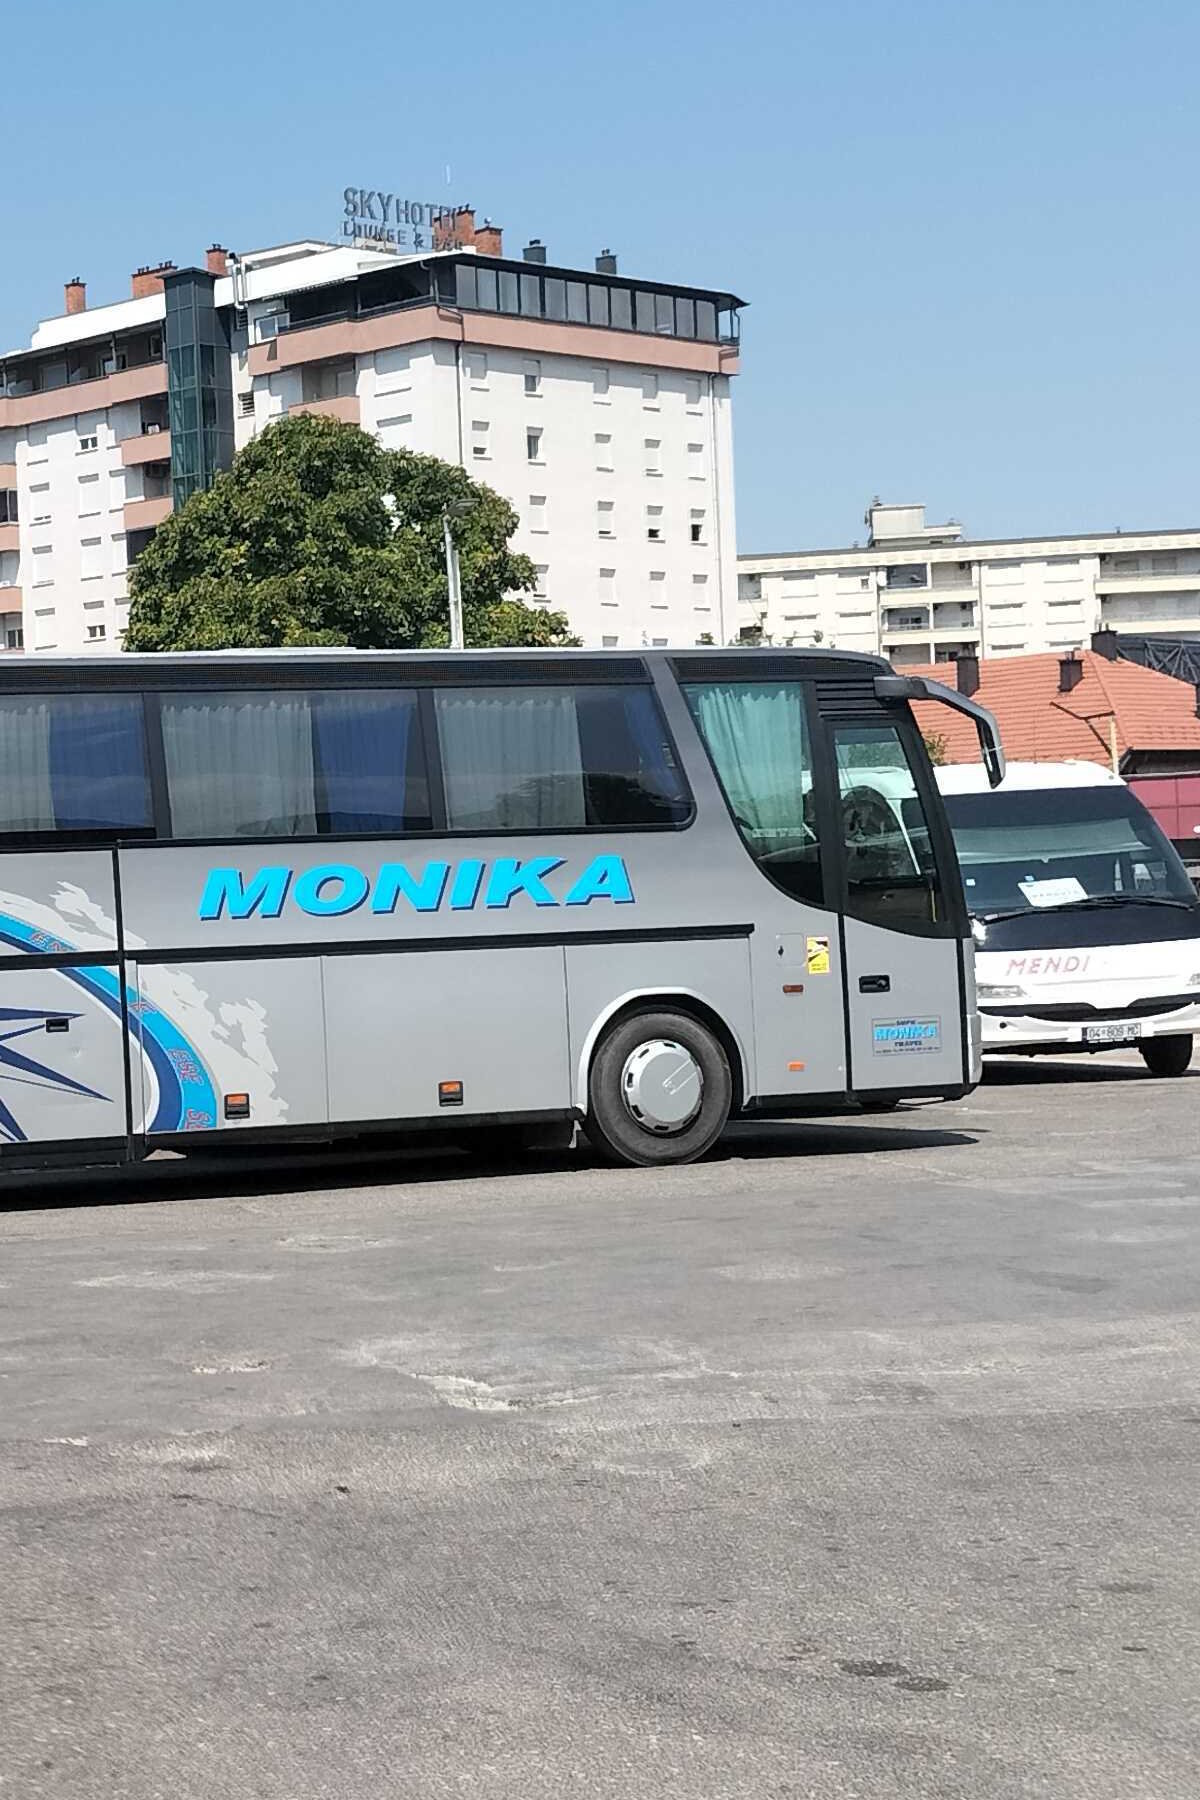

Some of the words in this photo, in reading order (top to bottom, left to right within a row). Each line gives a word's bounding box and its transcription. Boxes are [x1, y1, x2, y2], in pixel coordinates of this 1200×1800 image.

[343, 187, 393, 222] SKY
[199, 855, 635, 921] MONIKA
[1006, 955, 1091, 976] MENDI
